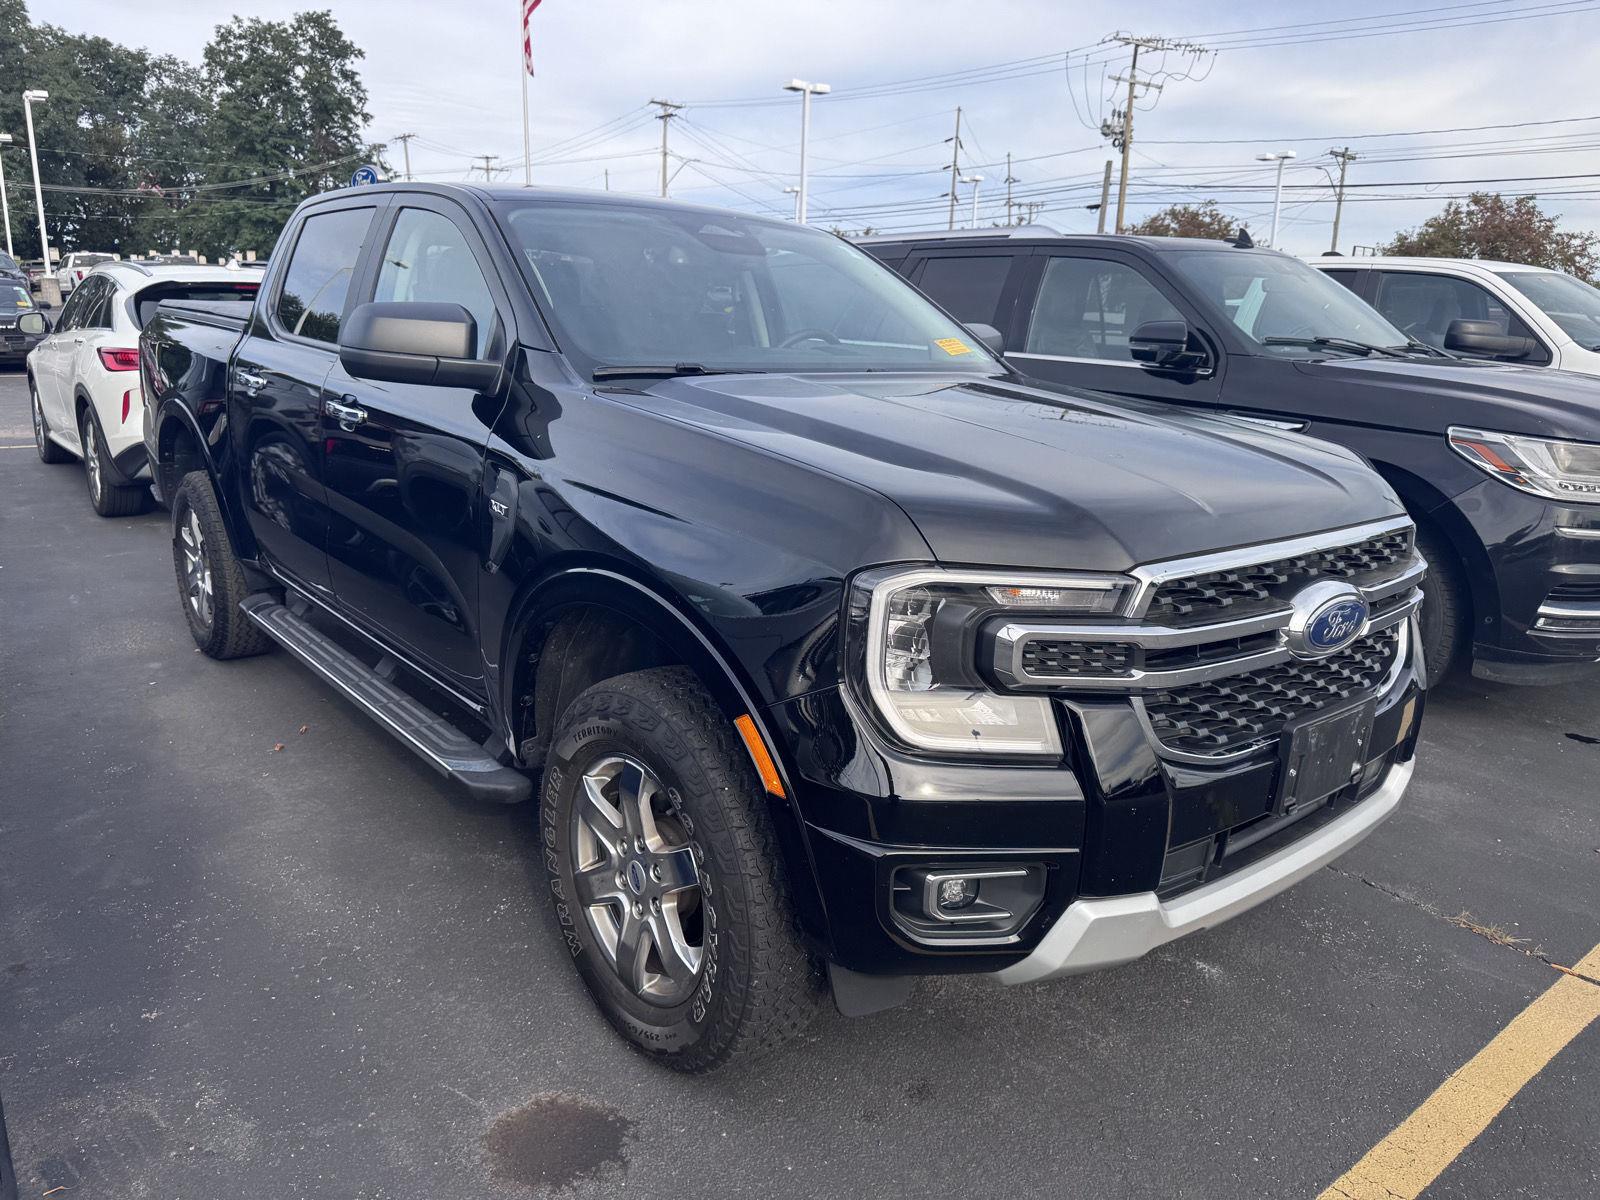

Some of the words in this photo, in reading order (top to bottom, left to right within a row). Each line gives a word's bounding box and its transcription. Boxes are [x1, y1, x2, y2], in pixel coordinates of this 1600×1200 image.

[490, 499, 509, 516] XLT
[1323, 607, 1359, 642] Ford
[573, 725, 618, 743] TERRITORY
[545, 766, 583, 957] WRANGLER
